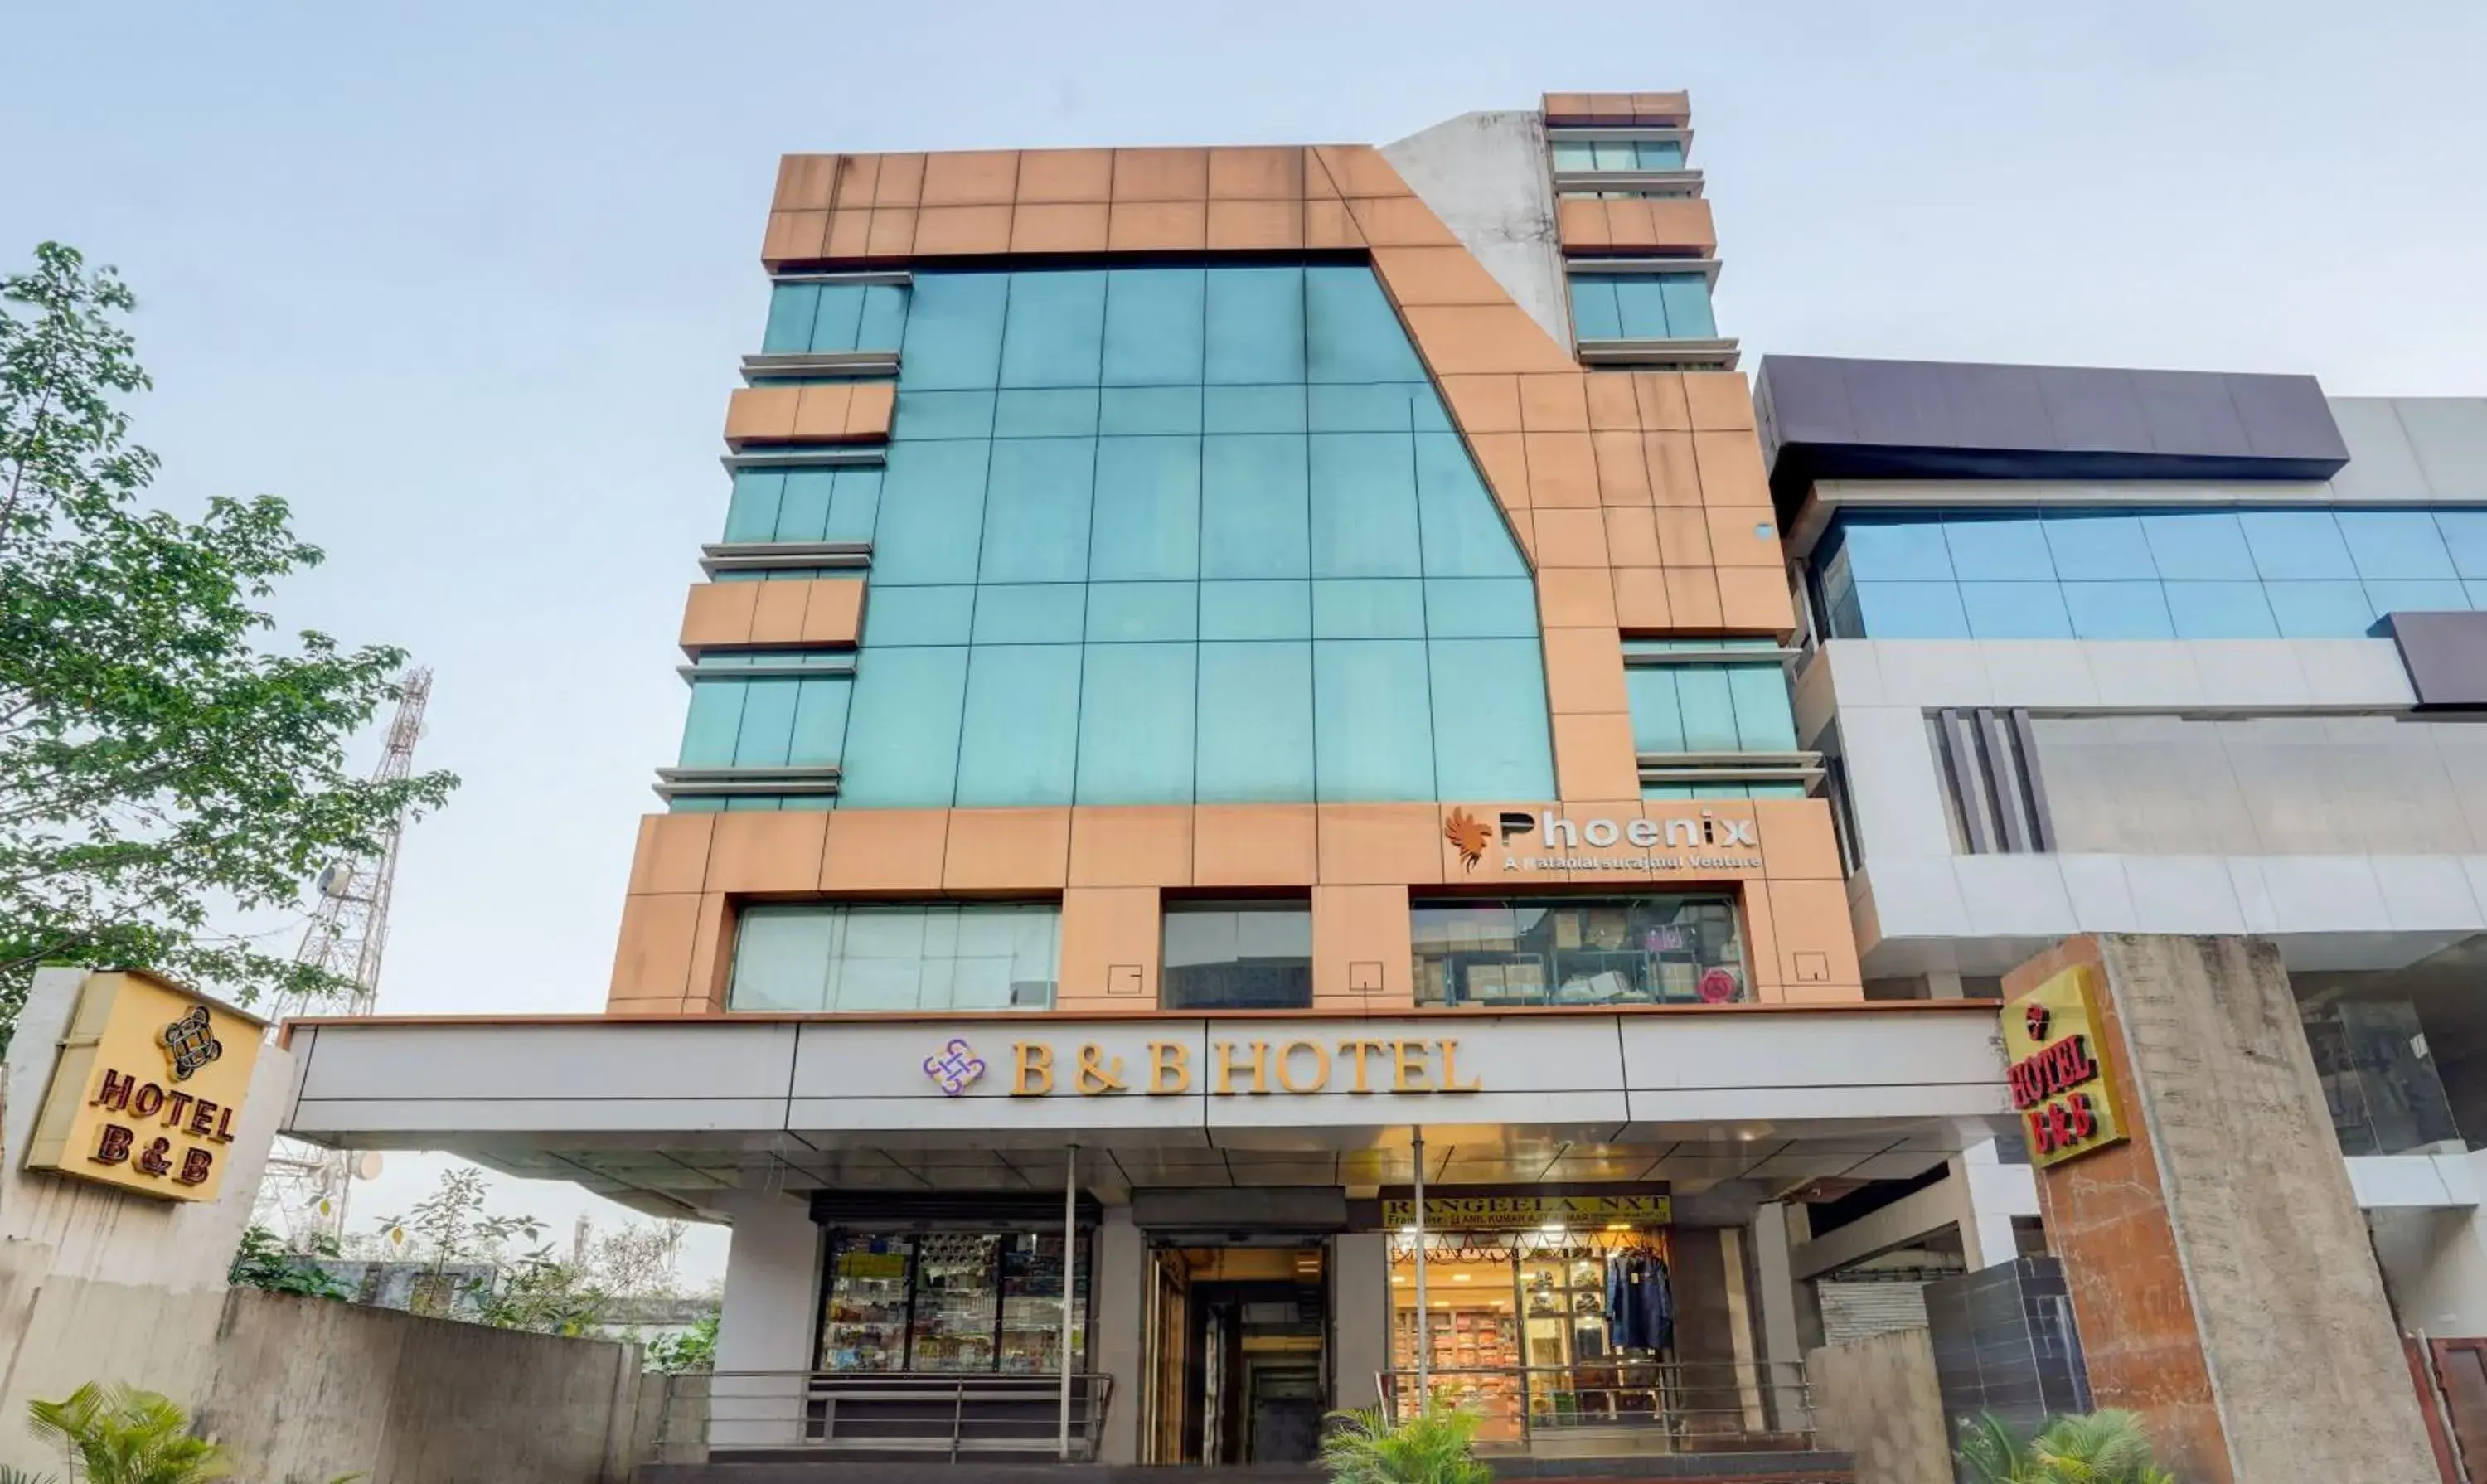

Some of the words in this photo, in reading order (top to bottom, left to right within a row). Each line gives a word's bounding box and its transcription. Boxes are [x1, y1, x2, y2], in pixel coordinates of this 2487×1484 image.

[1500, 808, 1758, 849] Phoenix
[1688, 854, 1762, 869] Venture
[1214, 1040, 1482, 1094] HOTEL
[2007, 1035, 2094, 1109] HOTEL
[96, 1068, 235, 1143] HOTEL
[1389, 1198, 1577, 1214] RANGEELA
[1600, 1196, 1667, 1210] NXT
